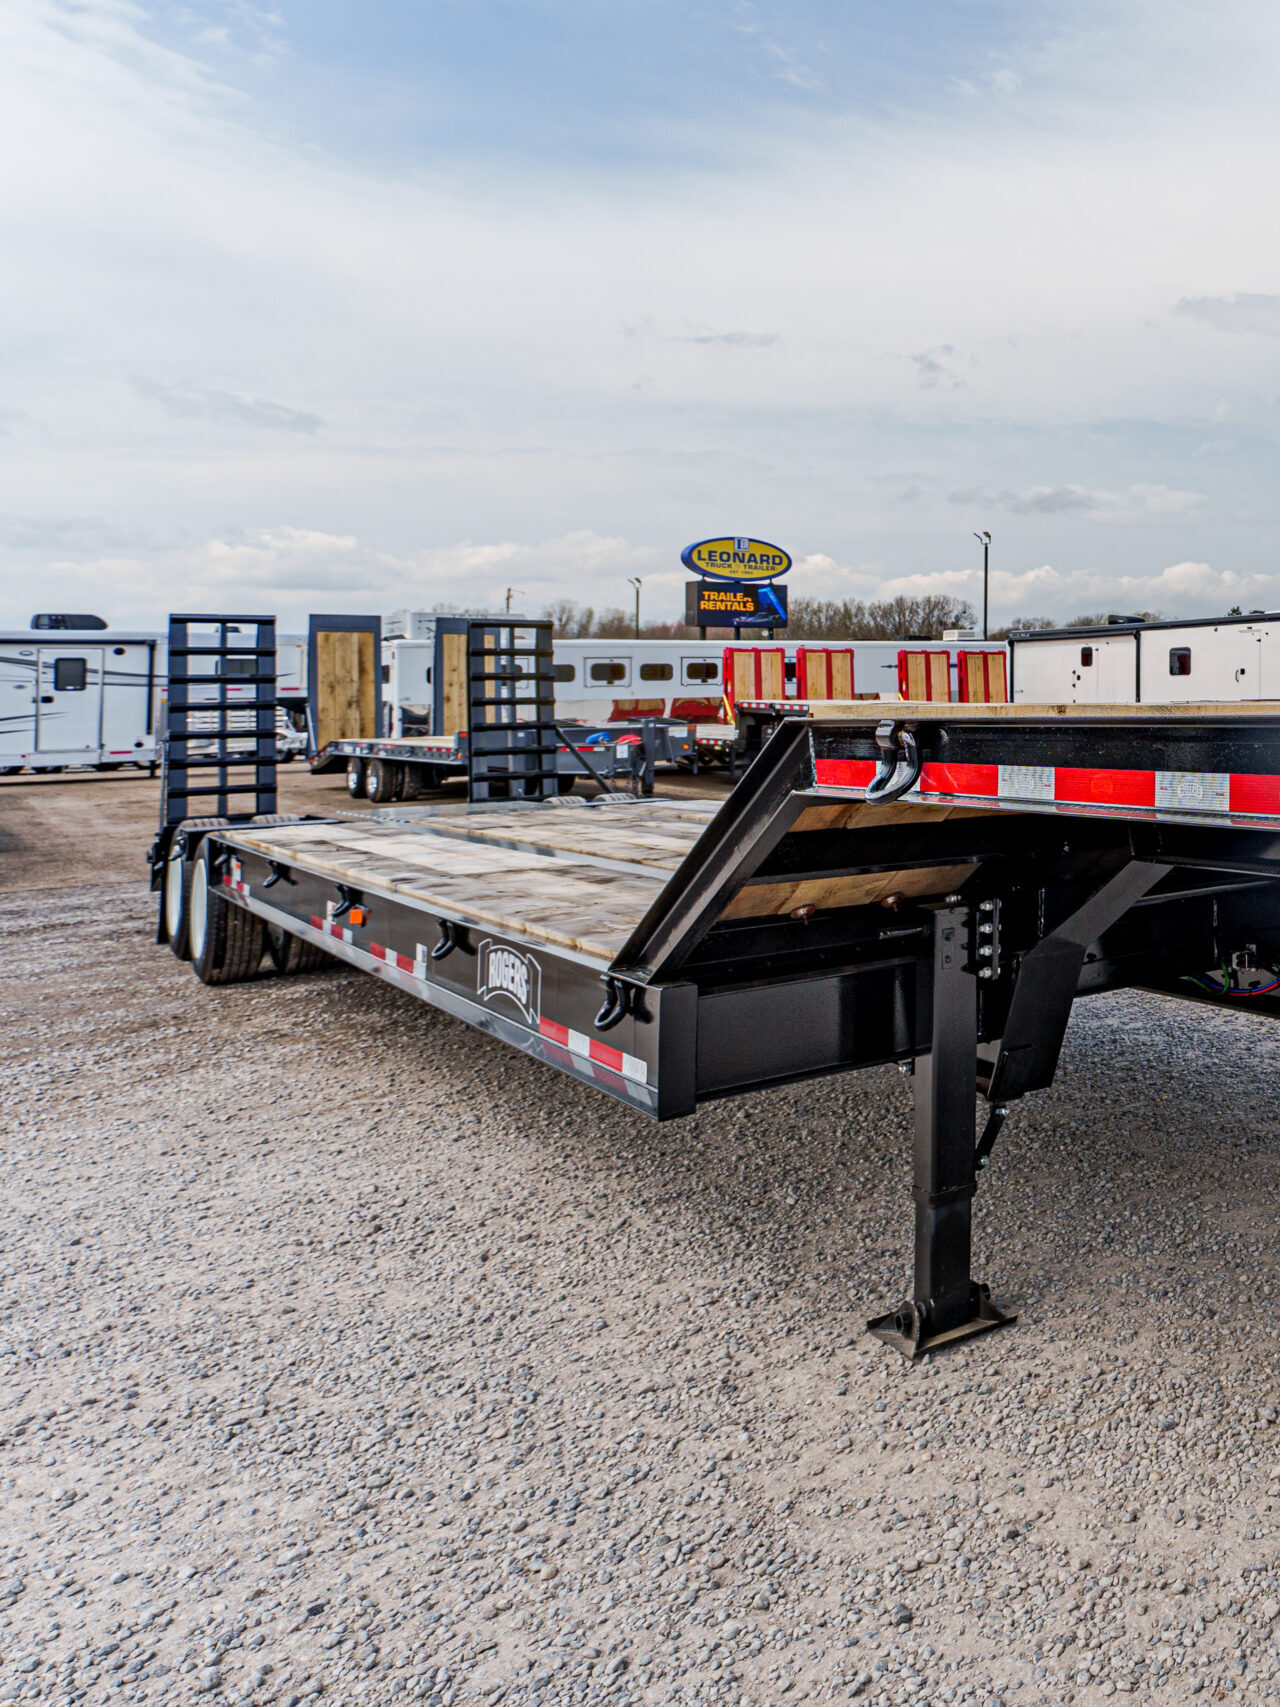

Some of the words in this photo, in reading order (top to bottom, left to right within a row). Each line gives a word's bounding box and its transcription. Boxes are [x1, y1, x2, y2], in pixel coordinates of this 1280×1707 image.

[697, 549, 783, 565] LEONARD
[744, 564, 776, 572] TRAILER
[700, 601, 754, 611] RENTALS
[488, 951, 528, 1004] ROGERS
